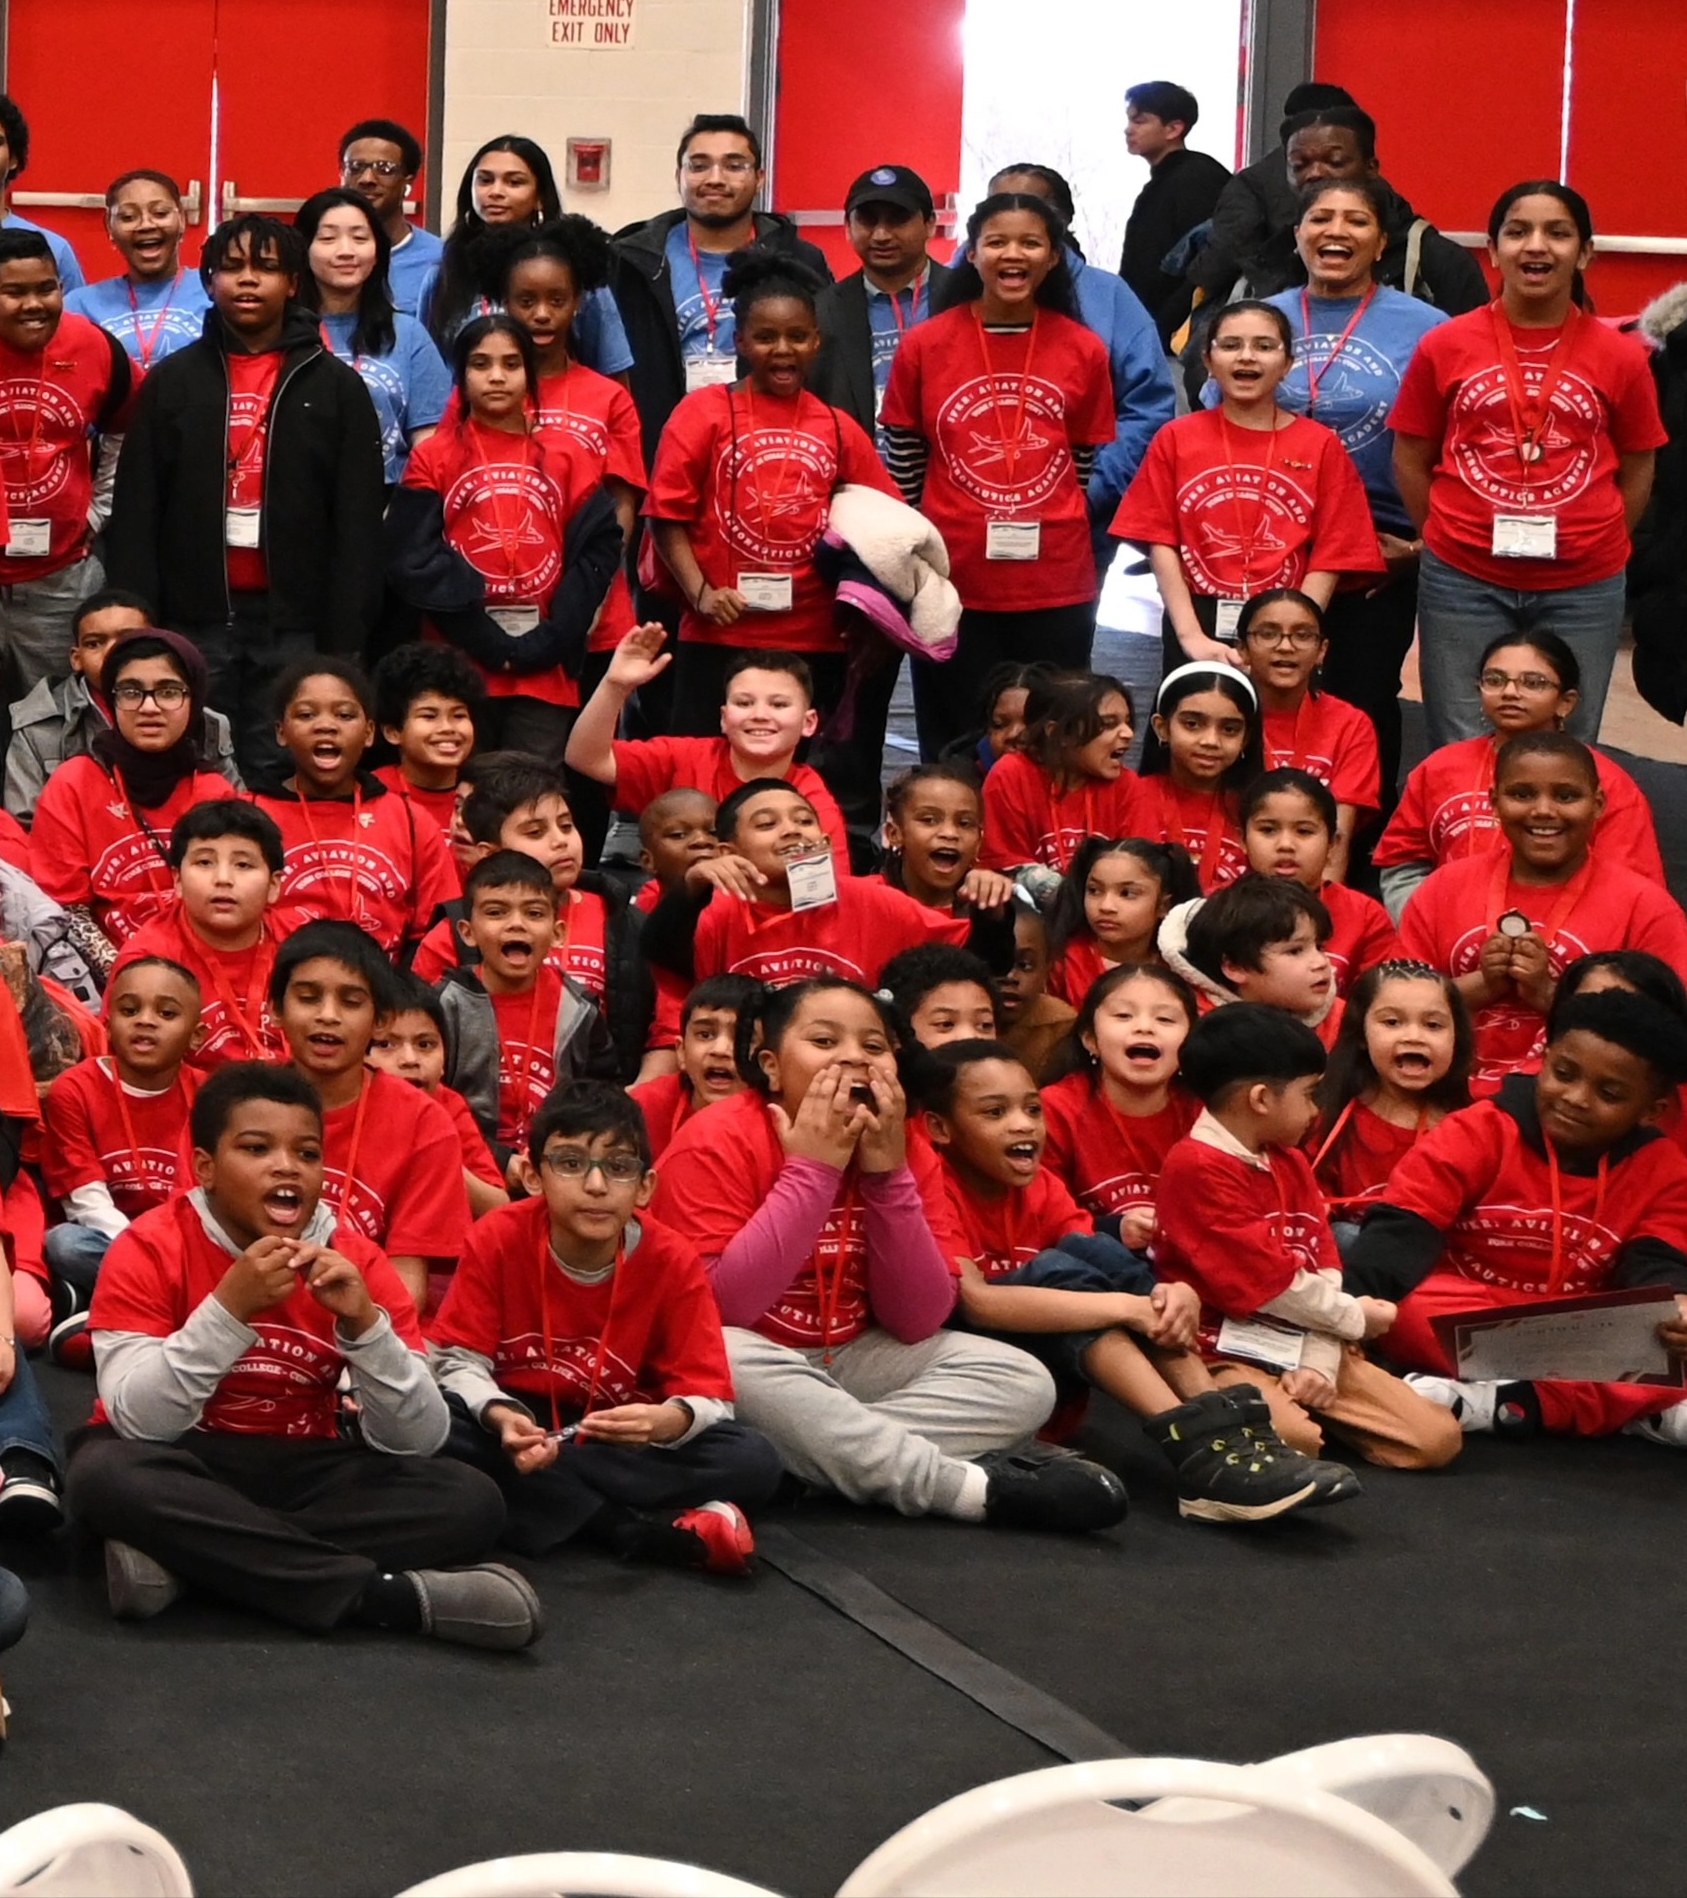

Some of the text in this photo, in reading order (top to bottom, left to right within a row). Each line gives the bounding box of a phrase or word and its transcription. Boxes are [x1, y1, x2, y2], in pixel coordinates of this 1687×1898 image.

[551, 21, 631, 44] EXIT ONLY
[1362, 356, 1384, 378] AND
[978, 381, 1042, 399] AVIATON
[1044, 397, 1065, 421] AND
[1569, 382, 1594, 420] AND
[1027, 448, 1067, 499] ACADEMY
[1542, 449, 1590, 501] ACADEMY
[1288, 493, 1309, 524] AND
[379, 866, 398, 900] AND
